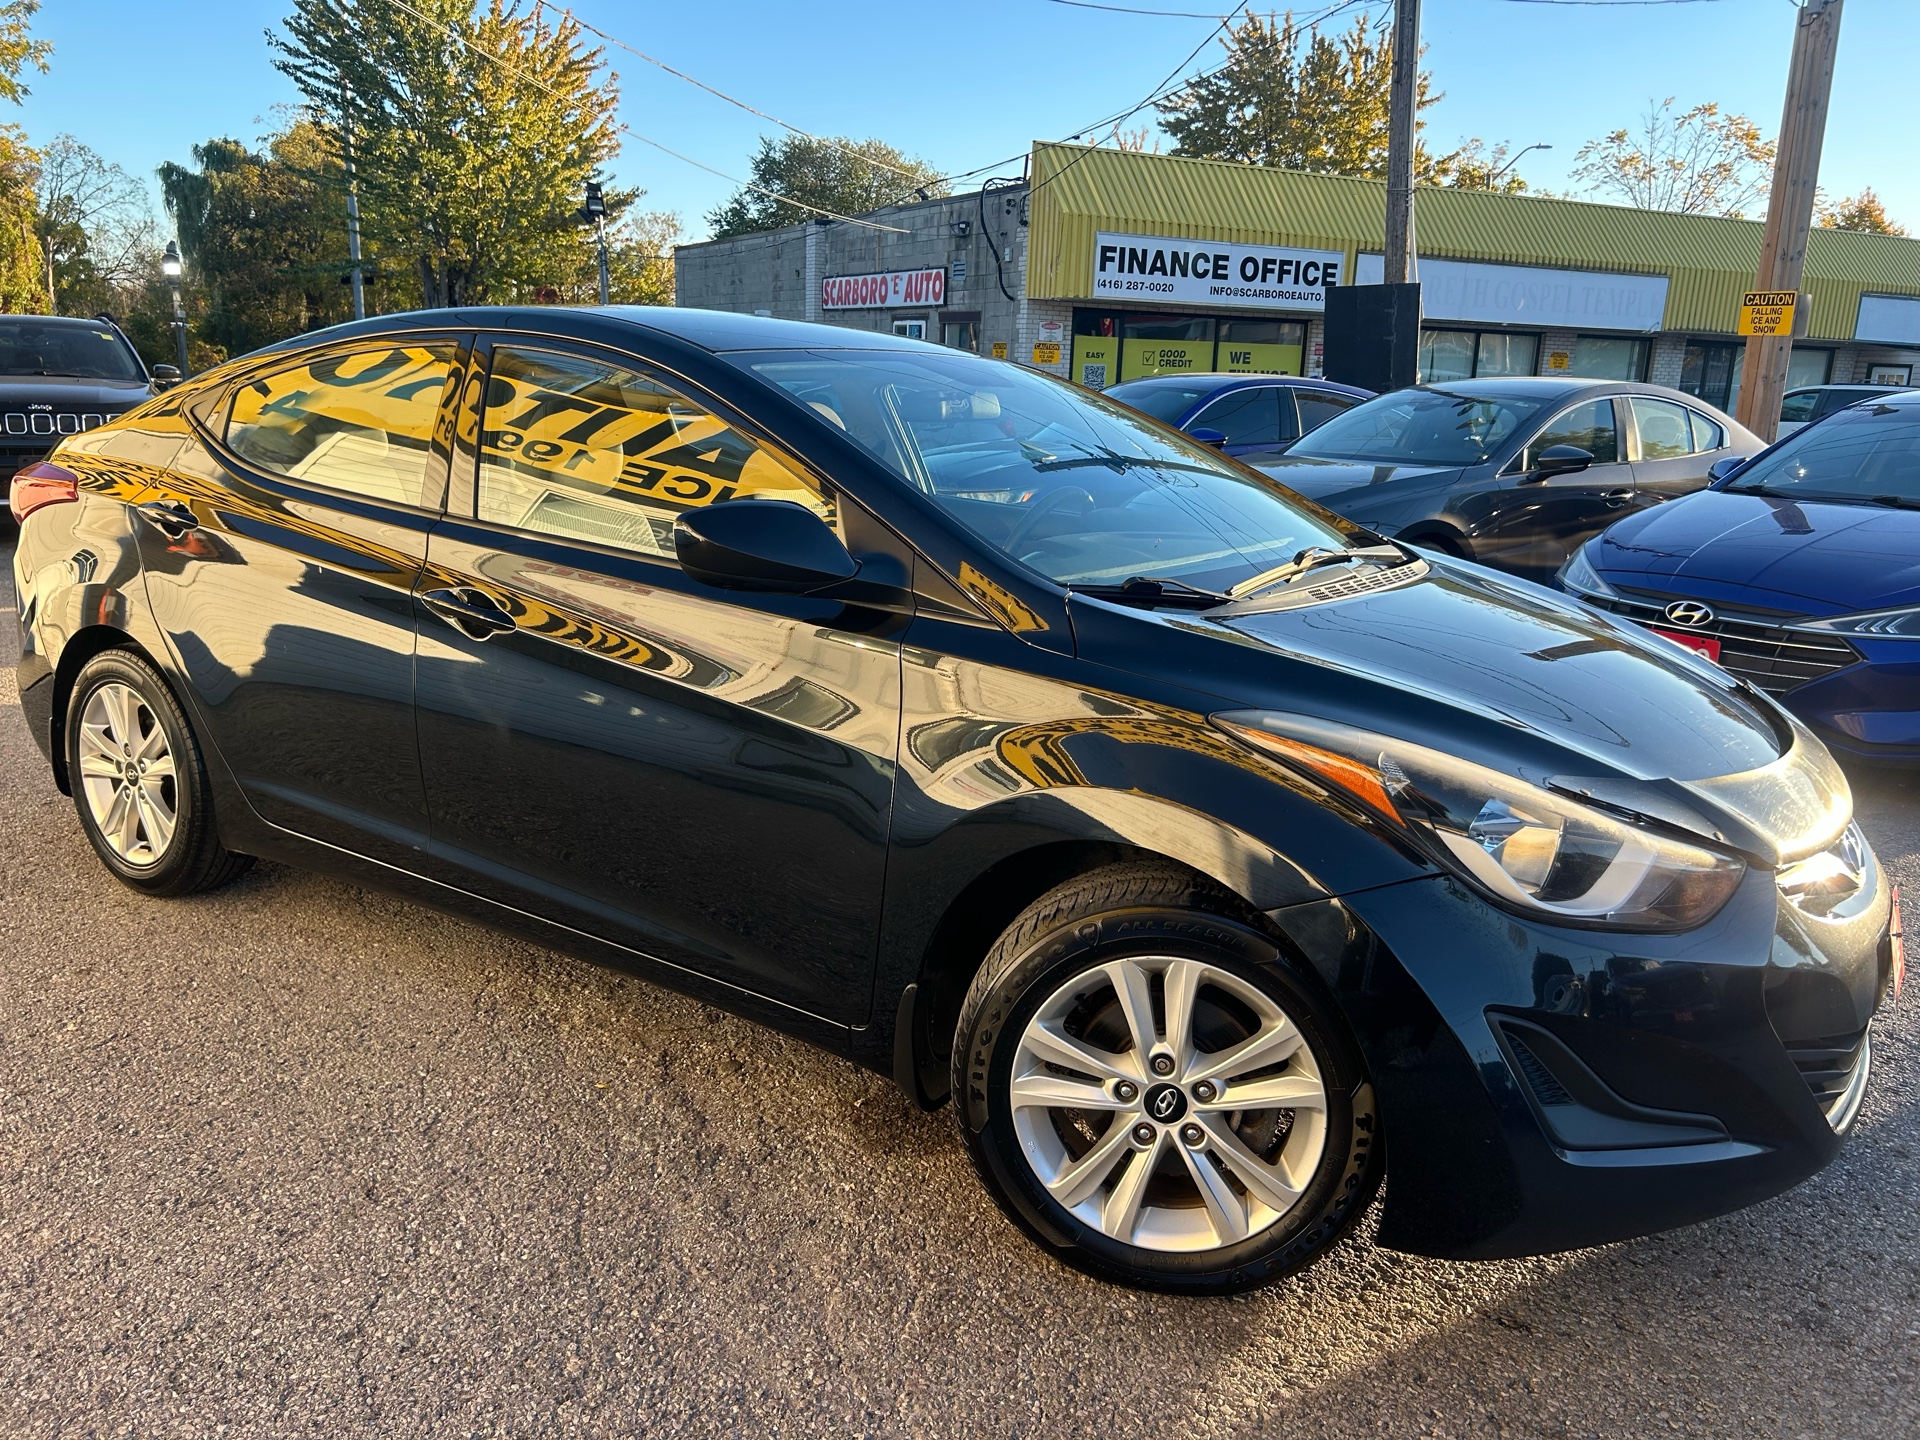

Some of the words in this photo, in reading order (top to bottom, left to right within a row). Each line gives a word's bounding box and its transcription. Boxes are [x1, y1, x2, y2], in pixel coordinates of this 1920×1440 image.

[1099, 245, 1230, 280] FINANCE
[1239, 256, 1338, 287] OFFICE
[823, 275, 888, 306] SCARBORO
[903, 271, 943, 303] AUTO
[1097, 279, 1123, 290] (416)
[1125, 280, 1174, 293] 287-0020
[1746, 294, 1793, 305] CAUTION
[1085, 352, 1106, 360] EASY
[1159, 350, 1187, 360] GOOD
[1229, 352, 1251, 365] WE
[1159, 359, 1193, 369] CREDIT
